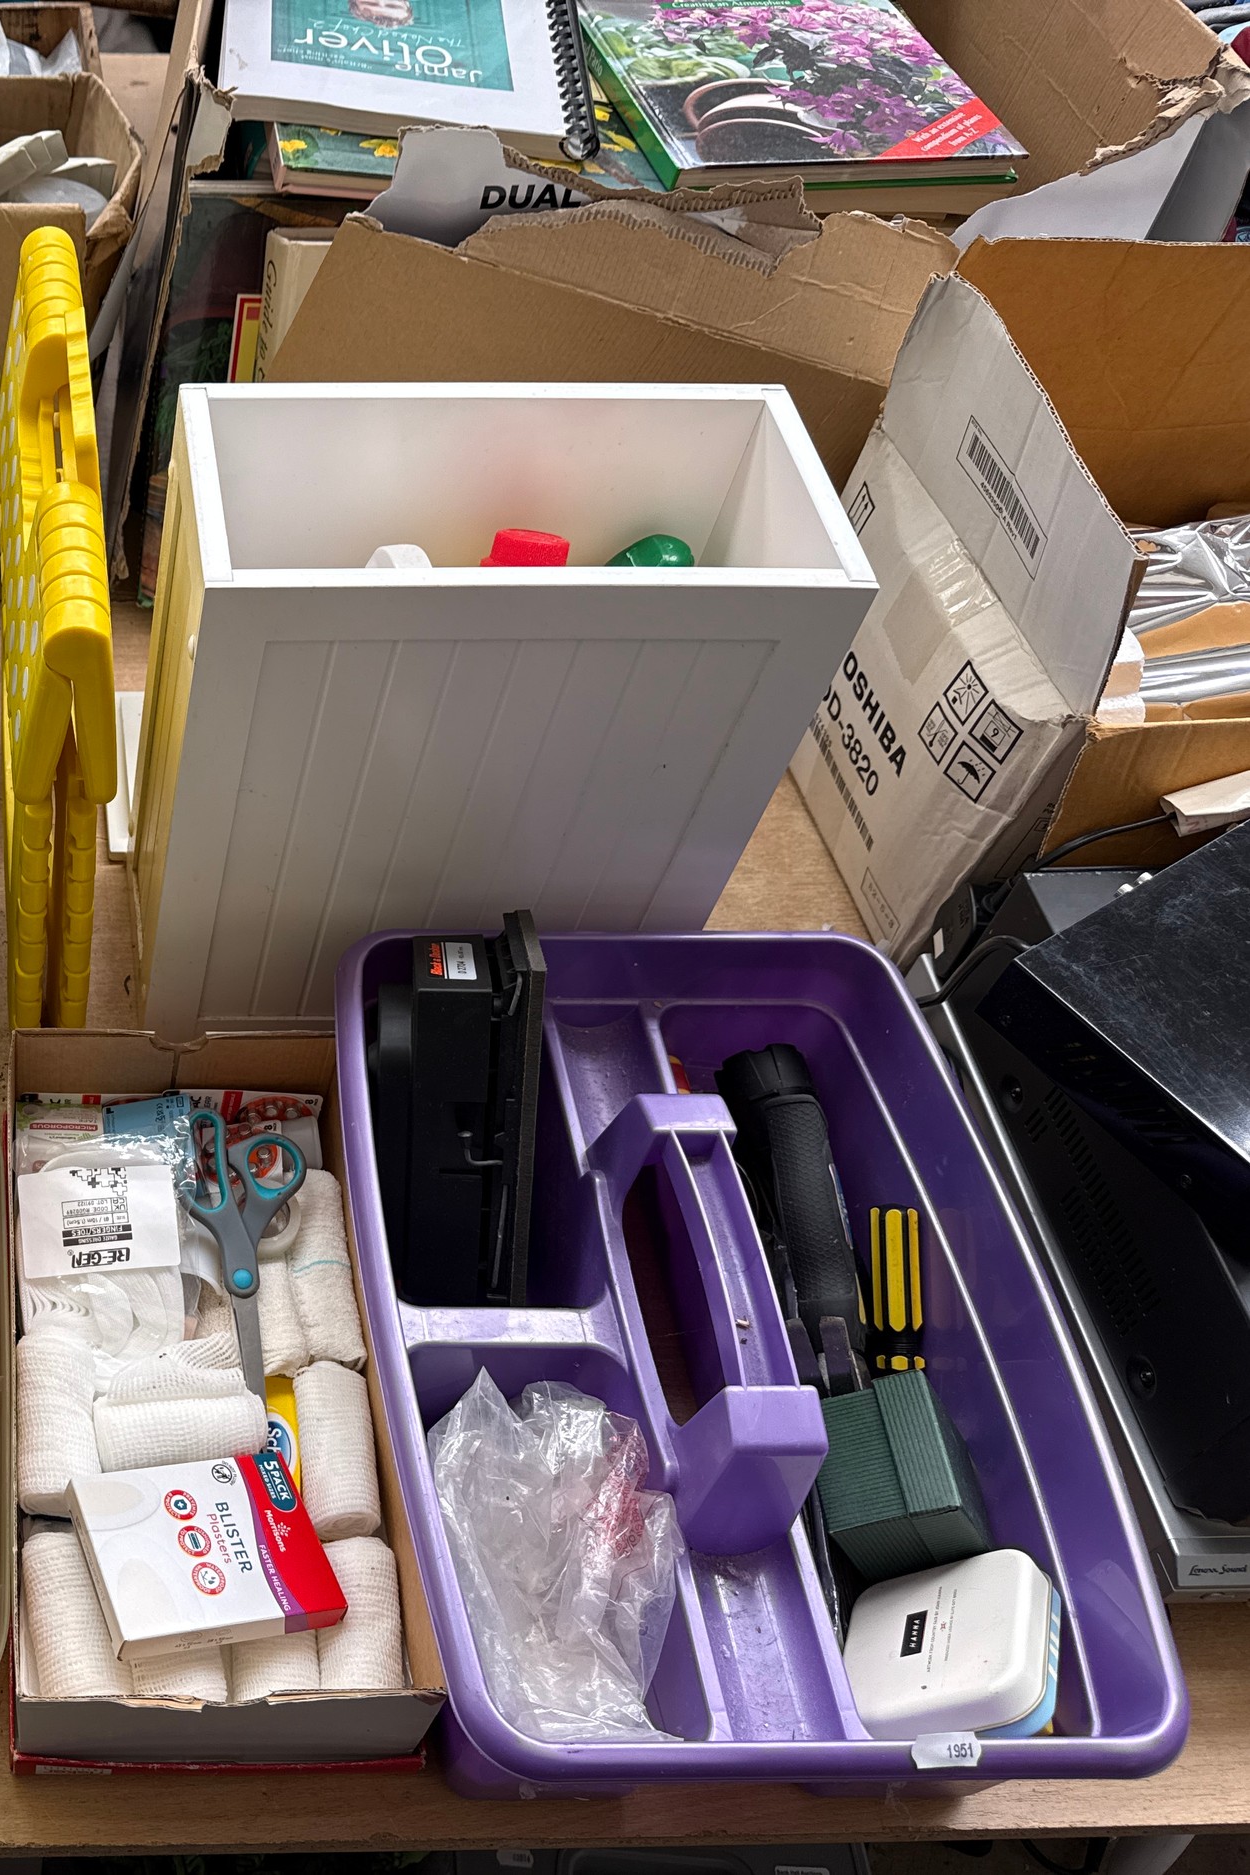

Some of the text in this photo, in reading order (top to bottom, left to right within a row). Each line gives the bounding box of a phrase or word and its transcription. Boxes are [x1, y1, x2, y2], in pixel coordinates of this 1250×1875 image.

[671, 1, 715, 9] Creating
[293, 27, 453, 68] Oliver
[395, 60, 483, 84] Jamie
[911, 130, 930, 144] With
[936, 111, 965, 130] extensive
[919, 126, 959, 153] compendium
[962, 112, 983, 128] plants
[948, 133, 966, 147] from
[480, 183, 582, 210] DUAL
[258, 260, 281, 333] Guide
[255, 334, 269, 359] to
[841, 650, 908, 779] OSHIBA
[71, 1225, 123, 1236] FINGERS/TOES
[71, 1247, 130, 1268] RE-GEN
[267, 1422, 282, 1453] Sch
[258, 1464, 277, 1500] MIXED SIZES
[264, 1460, 291, 1501] 5 PACK
[206, 1513, 232, 1564] Plasters
[214, 1501, 253, 1574] BLISTER
[264, 1509, 287, 1553] Morrisons
[258, 1544, 291, 1612] FASTER HEALING
[1218, 1563, 1248, 1575] Sound
[909, 1618, 921, 1648] HANNA
[946, 1742, 974, 1759] 1951
